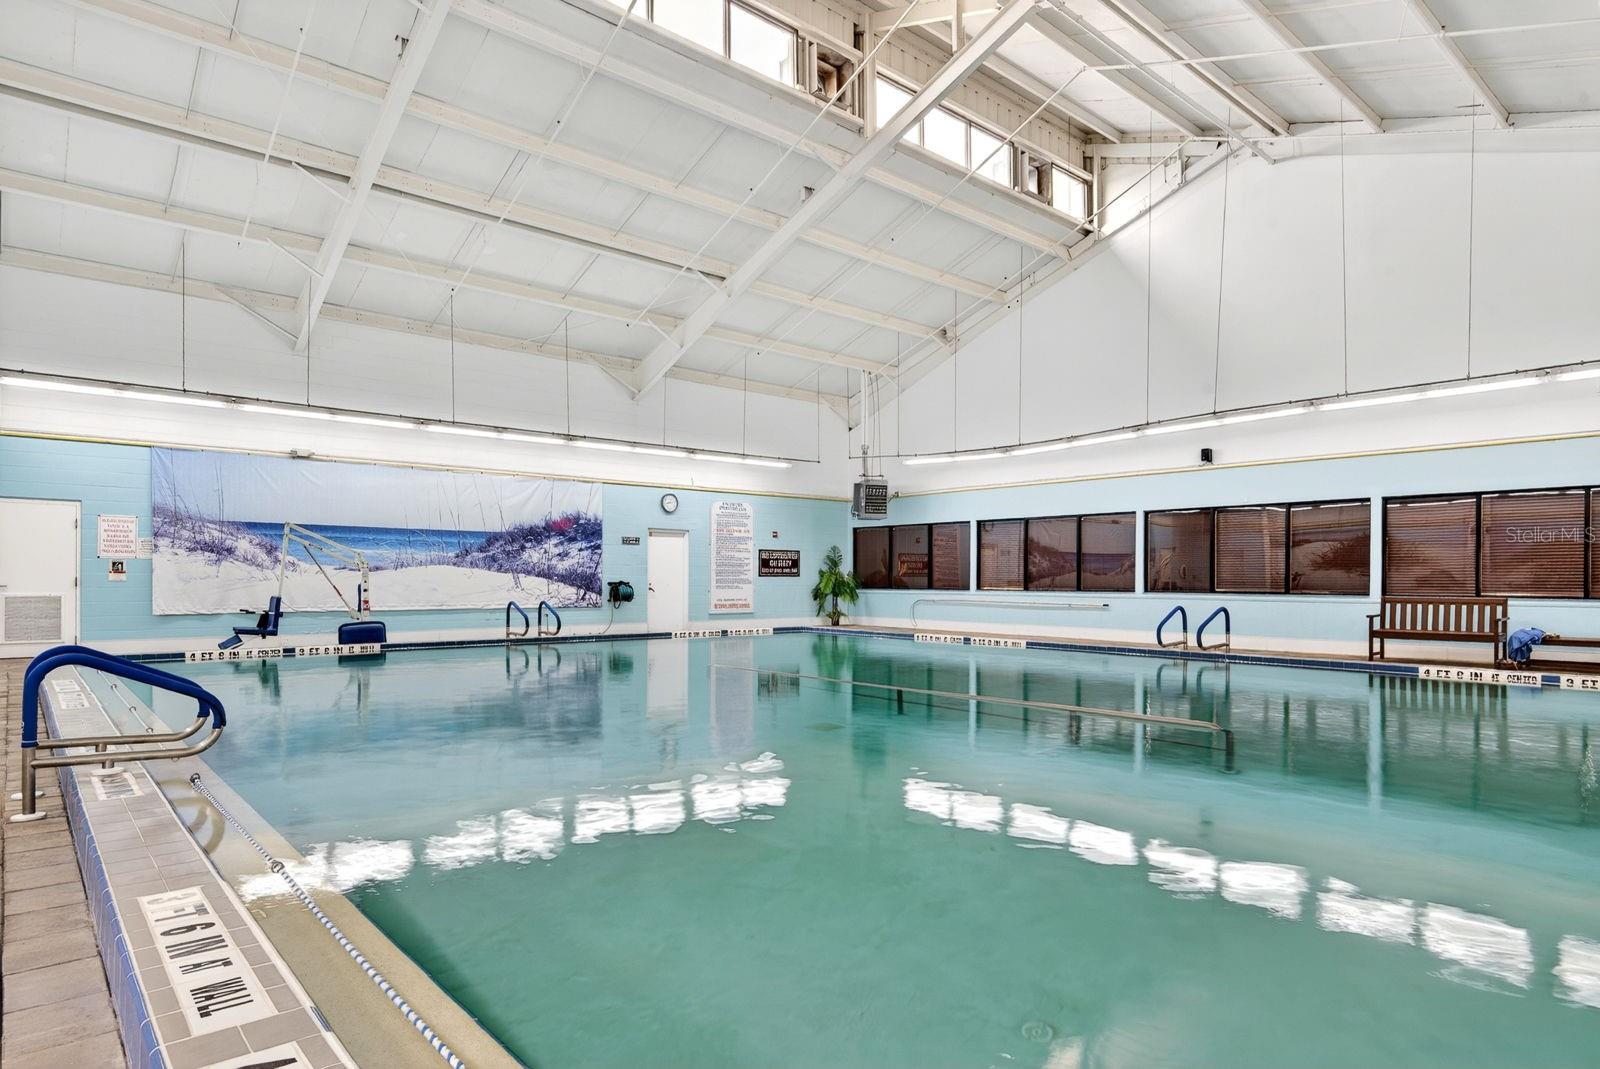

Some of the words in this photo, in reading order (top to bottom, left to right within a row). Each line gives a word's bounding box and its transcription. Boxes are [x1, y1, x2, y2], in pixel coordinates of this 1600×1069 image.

[1436, 669, 1451, 679] FT
[1470, 671, 1483, 682] IN
[1566, 678, 1574, 688] 3
[1581, 679, 1599, 690] FT
[160, 921, 216, 937] 6
[165, 934, 229, 960] IN
[179, 957, 234, 975] AT
[189, 976, 255, 1019] WALL
